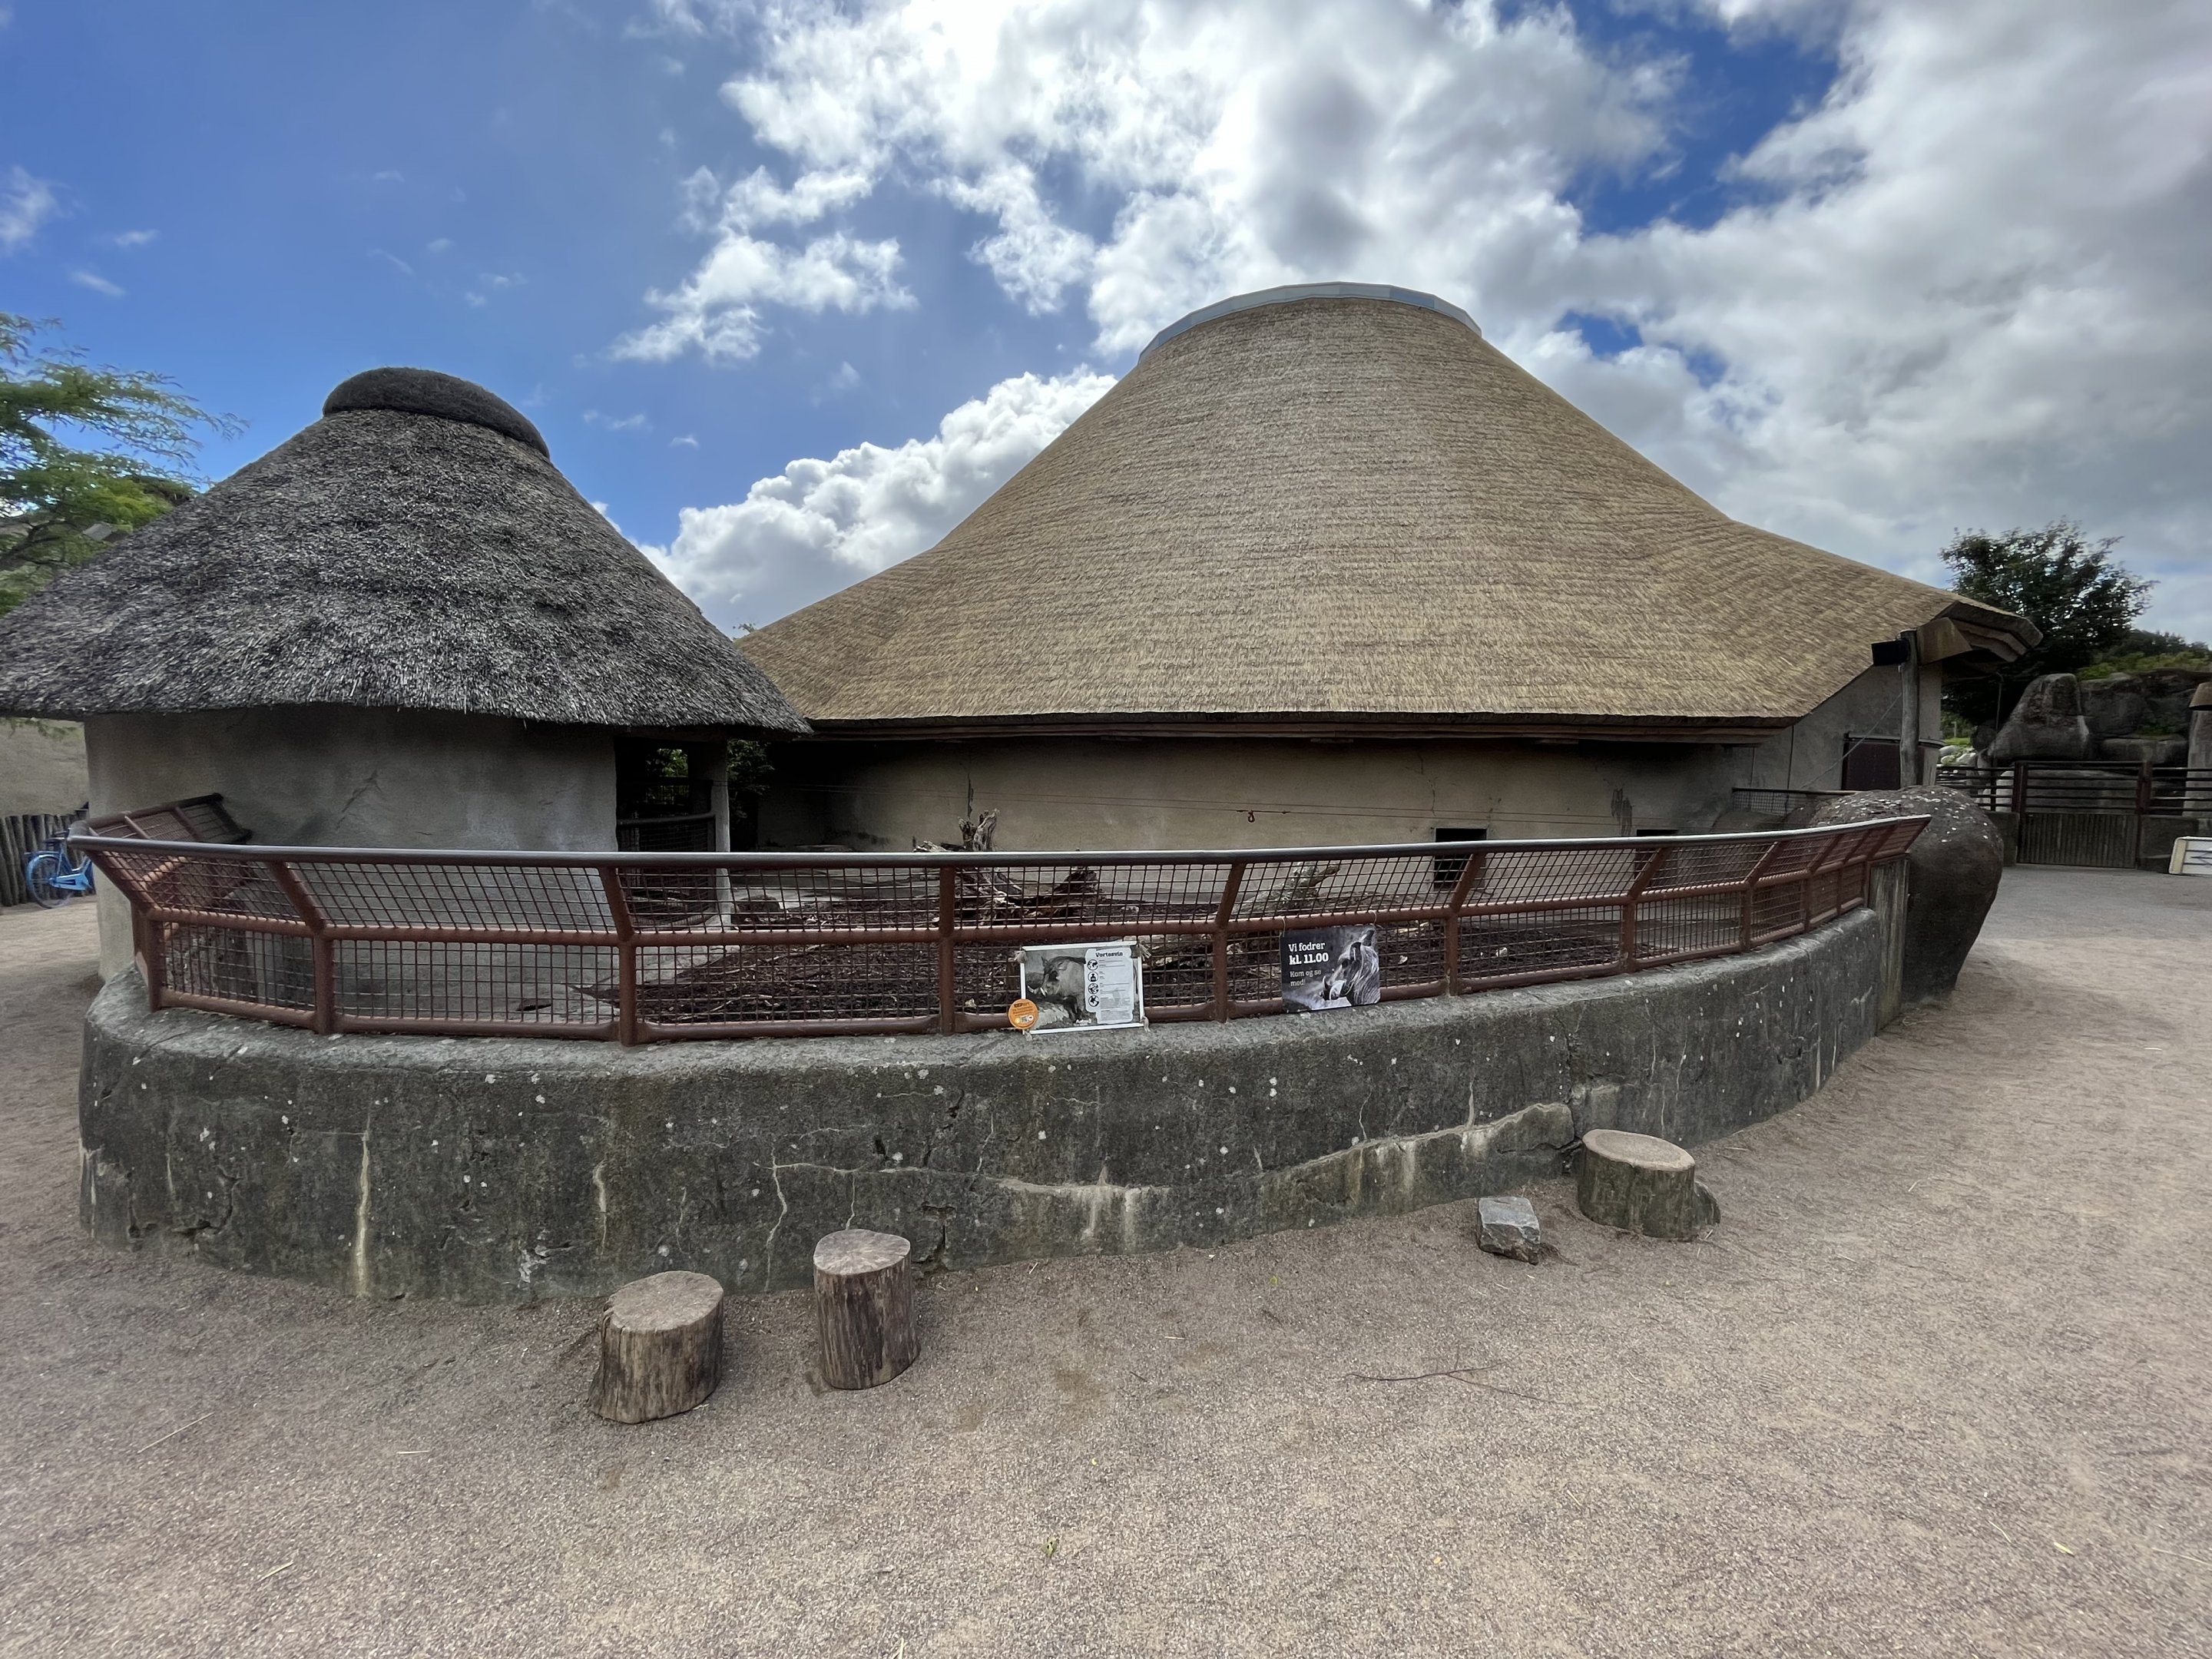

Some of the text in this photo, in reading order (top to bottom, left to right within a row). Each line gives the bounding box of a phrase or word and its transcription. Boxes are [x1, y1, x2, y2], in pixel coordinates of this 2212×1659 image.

[1288, 942, 1326, 952] Vi fodrer
[1289, 952, 1329, 965] kl. 11.00
